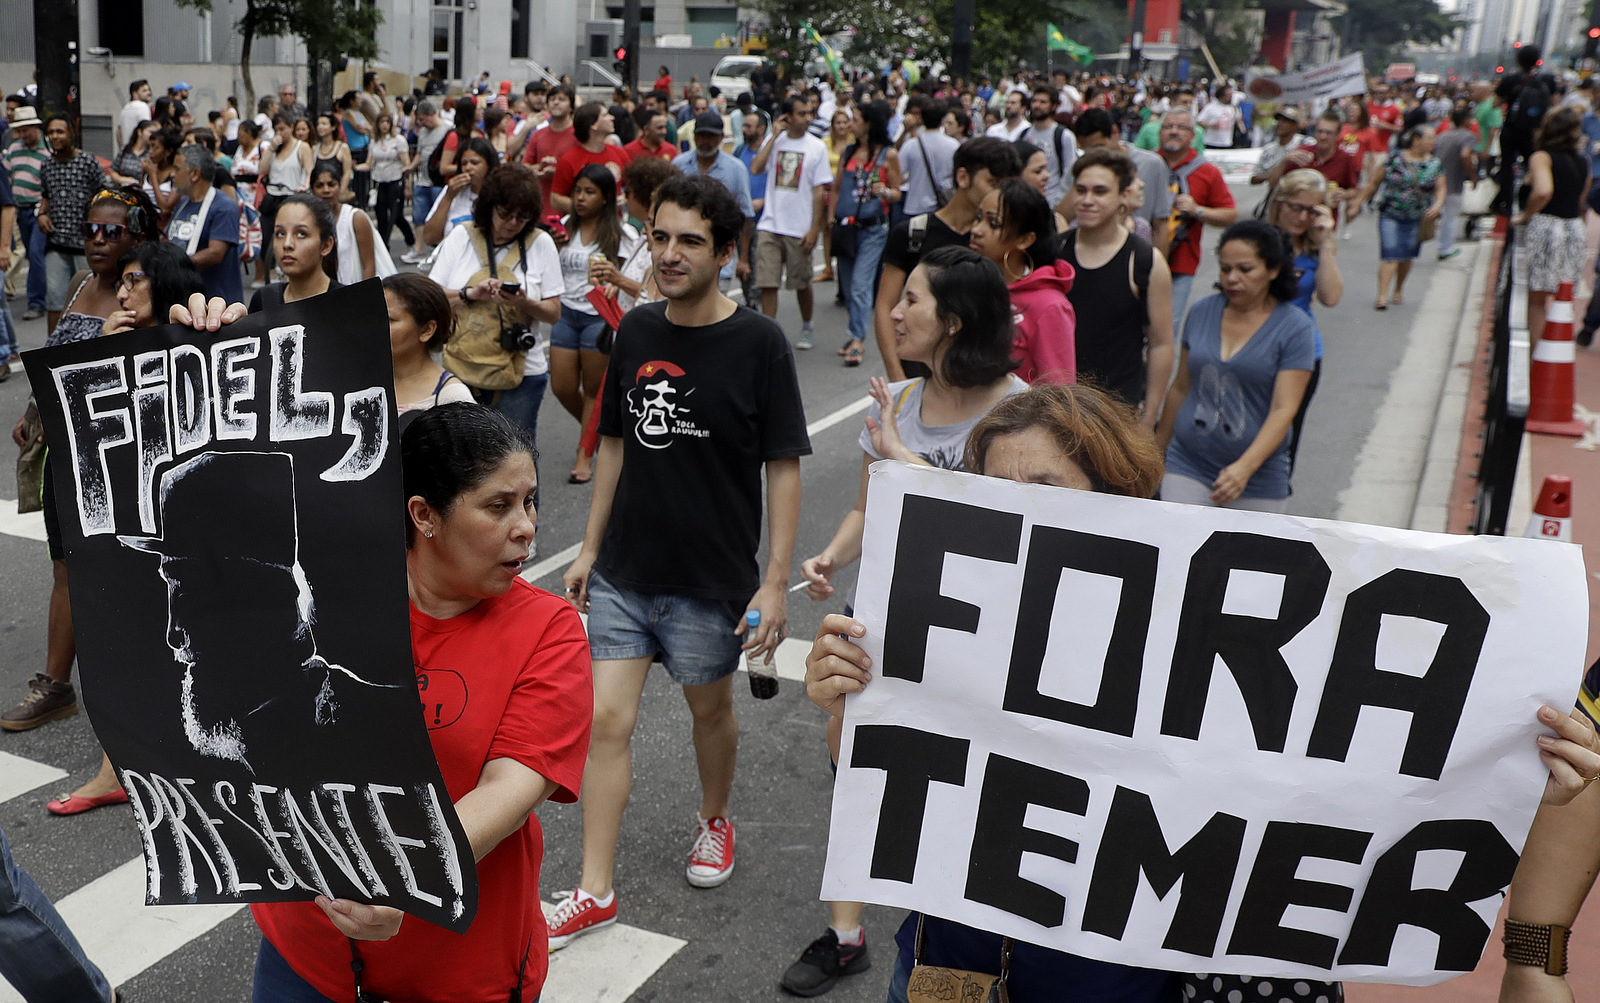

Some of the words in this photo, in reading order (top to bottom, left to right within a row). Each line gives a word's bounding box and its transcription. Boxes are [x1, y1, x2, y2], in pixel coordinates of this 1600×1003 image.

[675, 420, 696, 428] TOCA
[883, 493, 1491, 781] FORA
[850, 724, 1520, 972] TEMER
